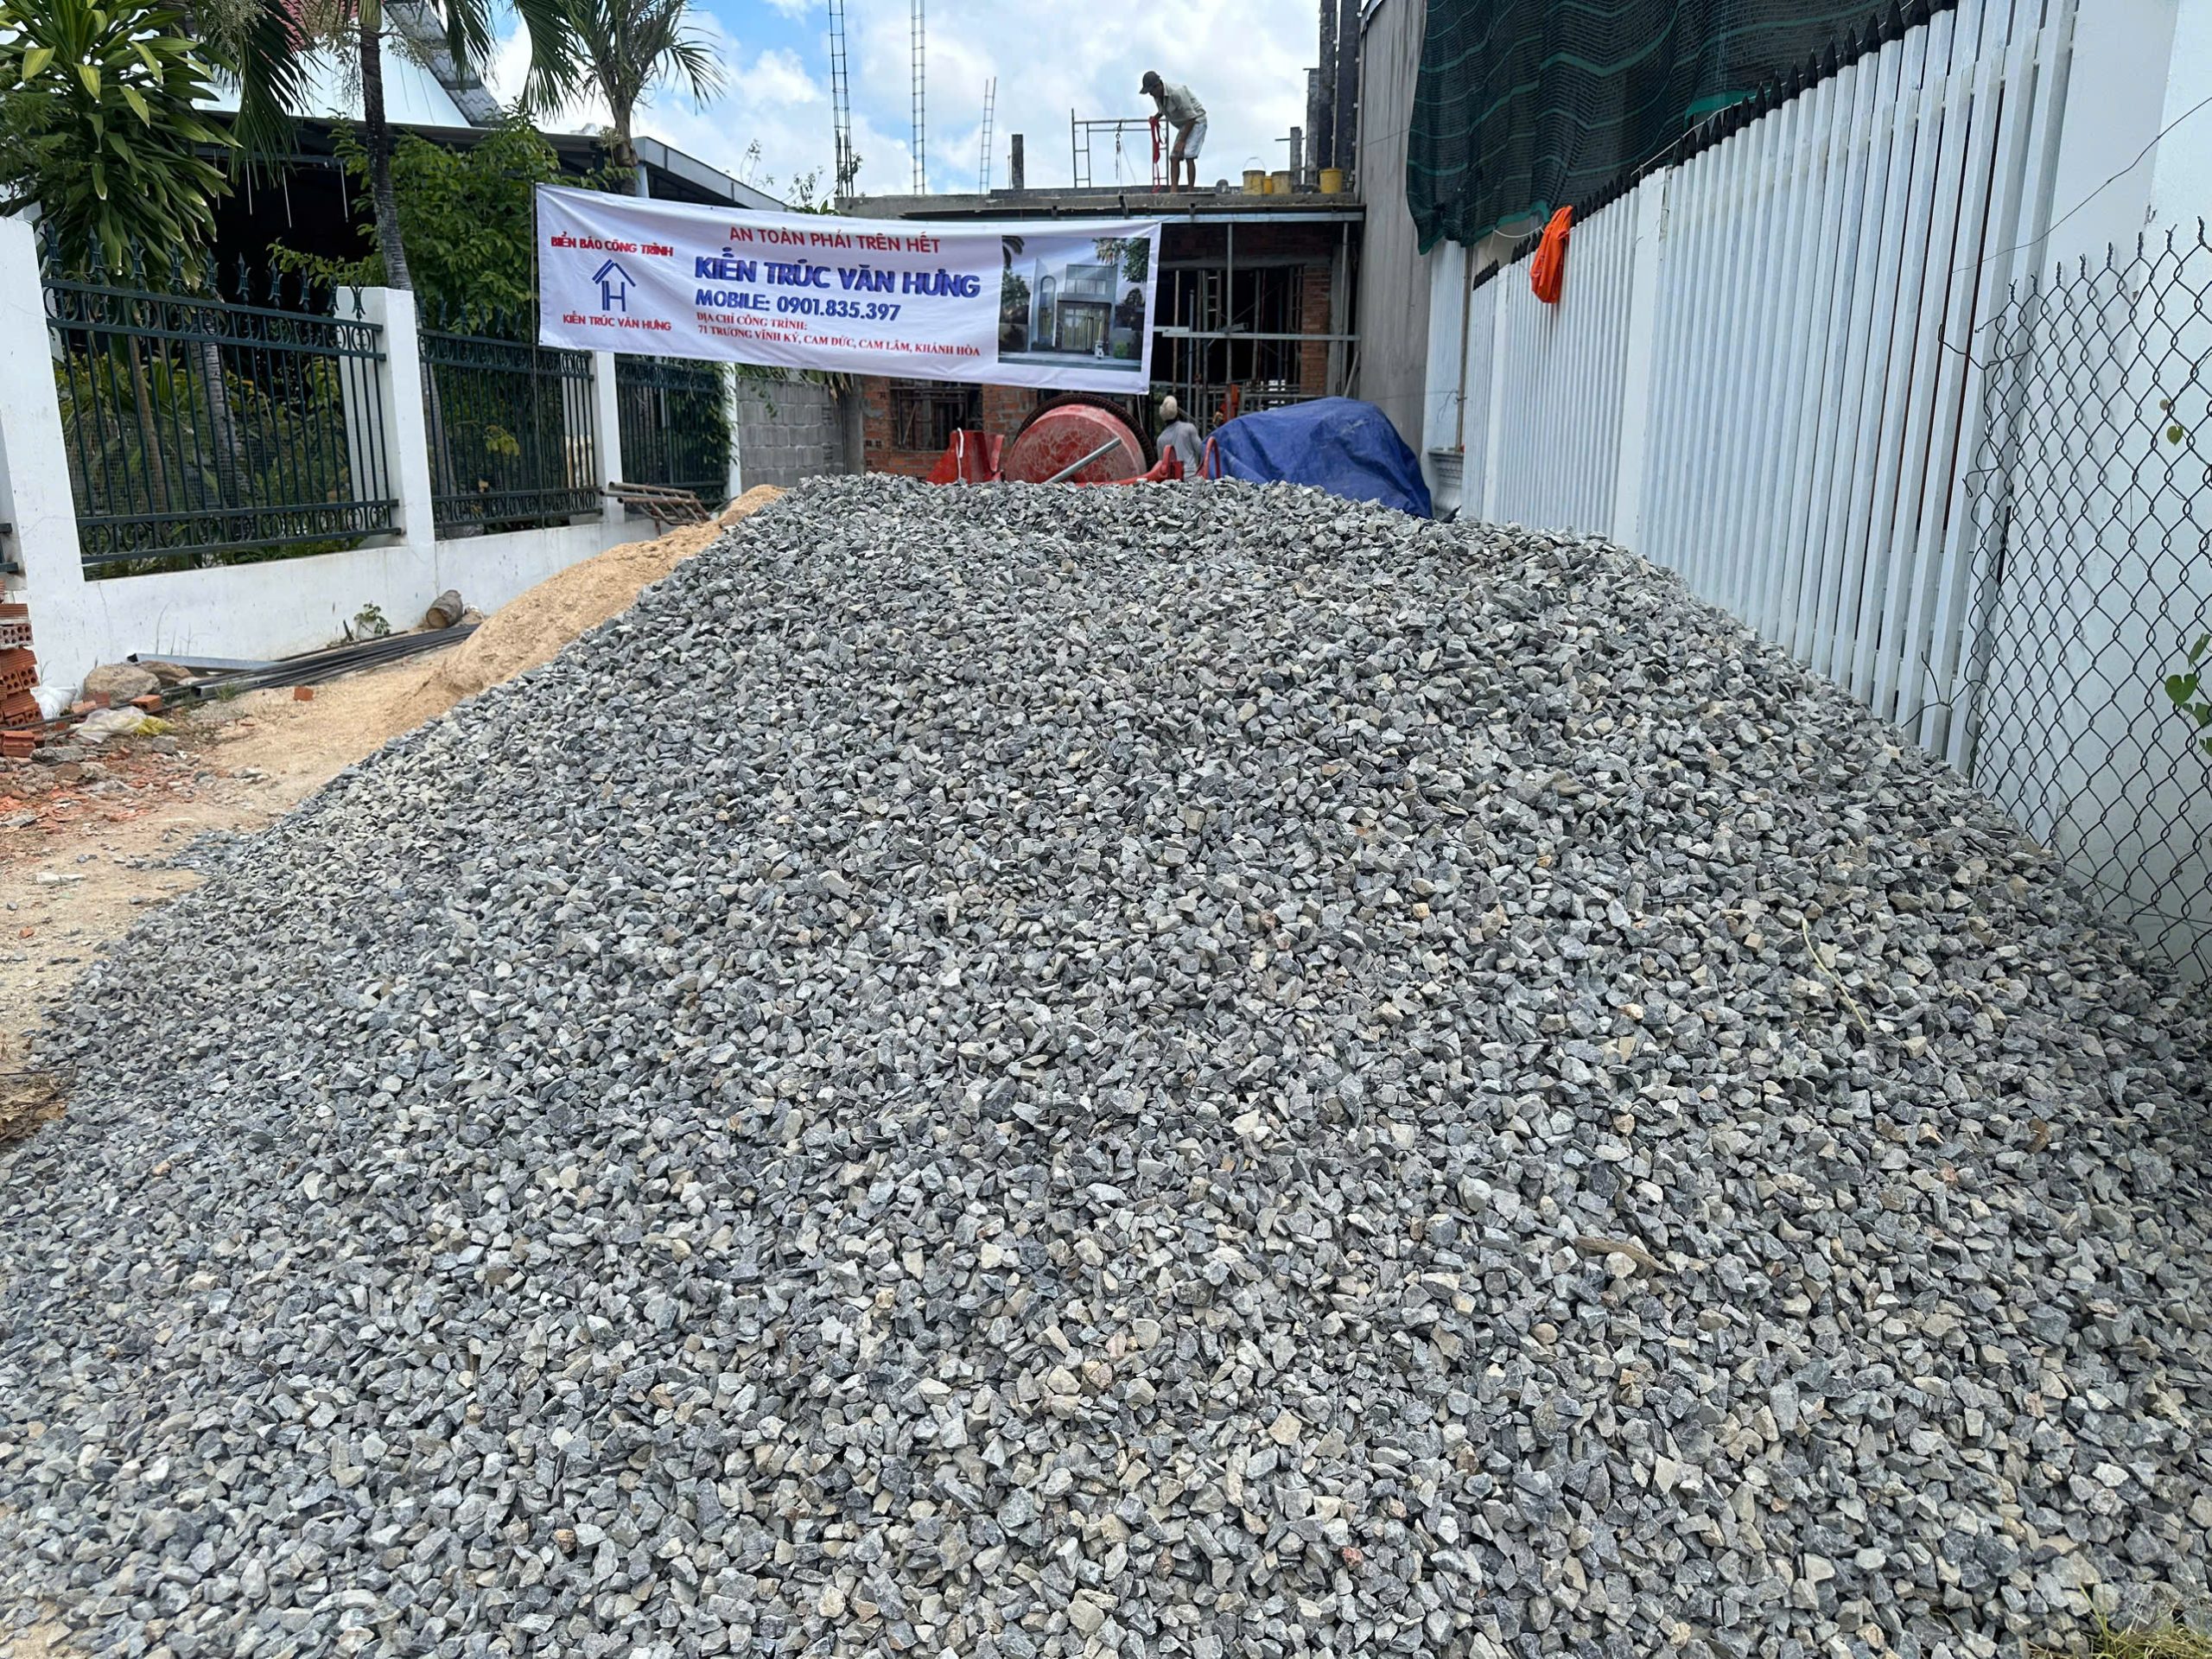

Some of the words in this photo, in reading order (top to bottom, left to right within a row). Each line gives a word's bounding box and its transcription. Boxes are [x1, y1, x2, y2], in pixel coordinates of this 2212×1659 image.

[551, 231, 577, 248] BIỂN
[579, 236, 602, 250] BÁO
[605, 238, 638, 253] CÔNG
[640, 243, 674, 257] TRÌNH
[729, 226, 753, 242] AN
[758, 227, 805, 245] TOÀN
[810, 229, 851, 248] PHẢI
[856, 233, 900, 251] TRÊN
[906, 231, 940, 253] HẾT
[764, 258, 831, 289] TRÚC
[837, 264, 896, 293] VĂN
[902, 268, 981, 298] HƯNG
[696, 289, 771, 311] MOBILE:
[777, 296, 901, 321] 0901.835.397
[588, 315, 615, 327] TRÚC
[618, 316, 639, 328] VĂN
[736, 315, 768, 327] CÔNG
[771, 318, 808, 331] TRÌNH:
[698, 325, 708, 334] 71
[804, 334, 828, 346] CAM
[859, 339, 883, 350] CAM
[886, 340, 913, 353] LÂM,
[915, 342, 954, 355] KHÁNH
[957, 343, 981, 357] HÒA
